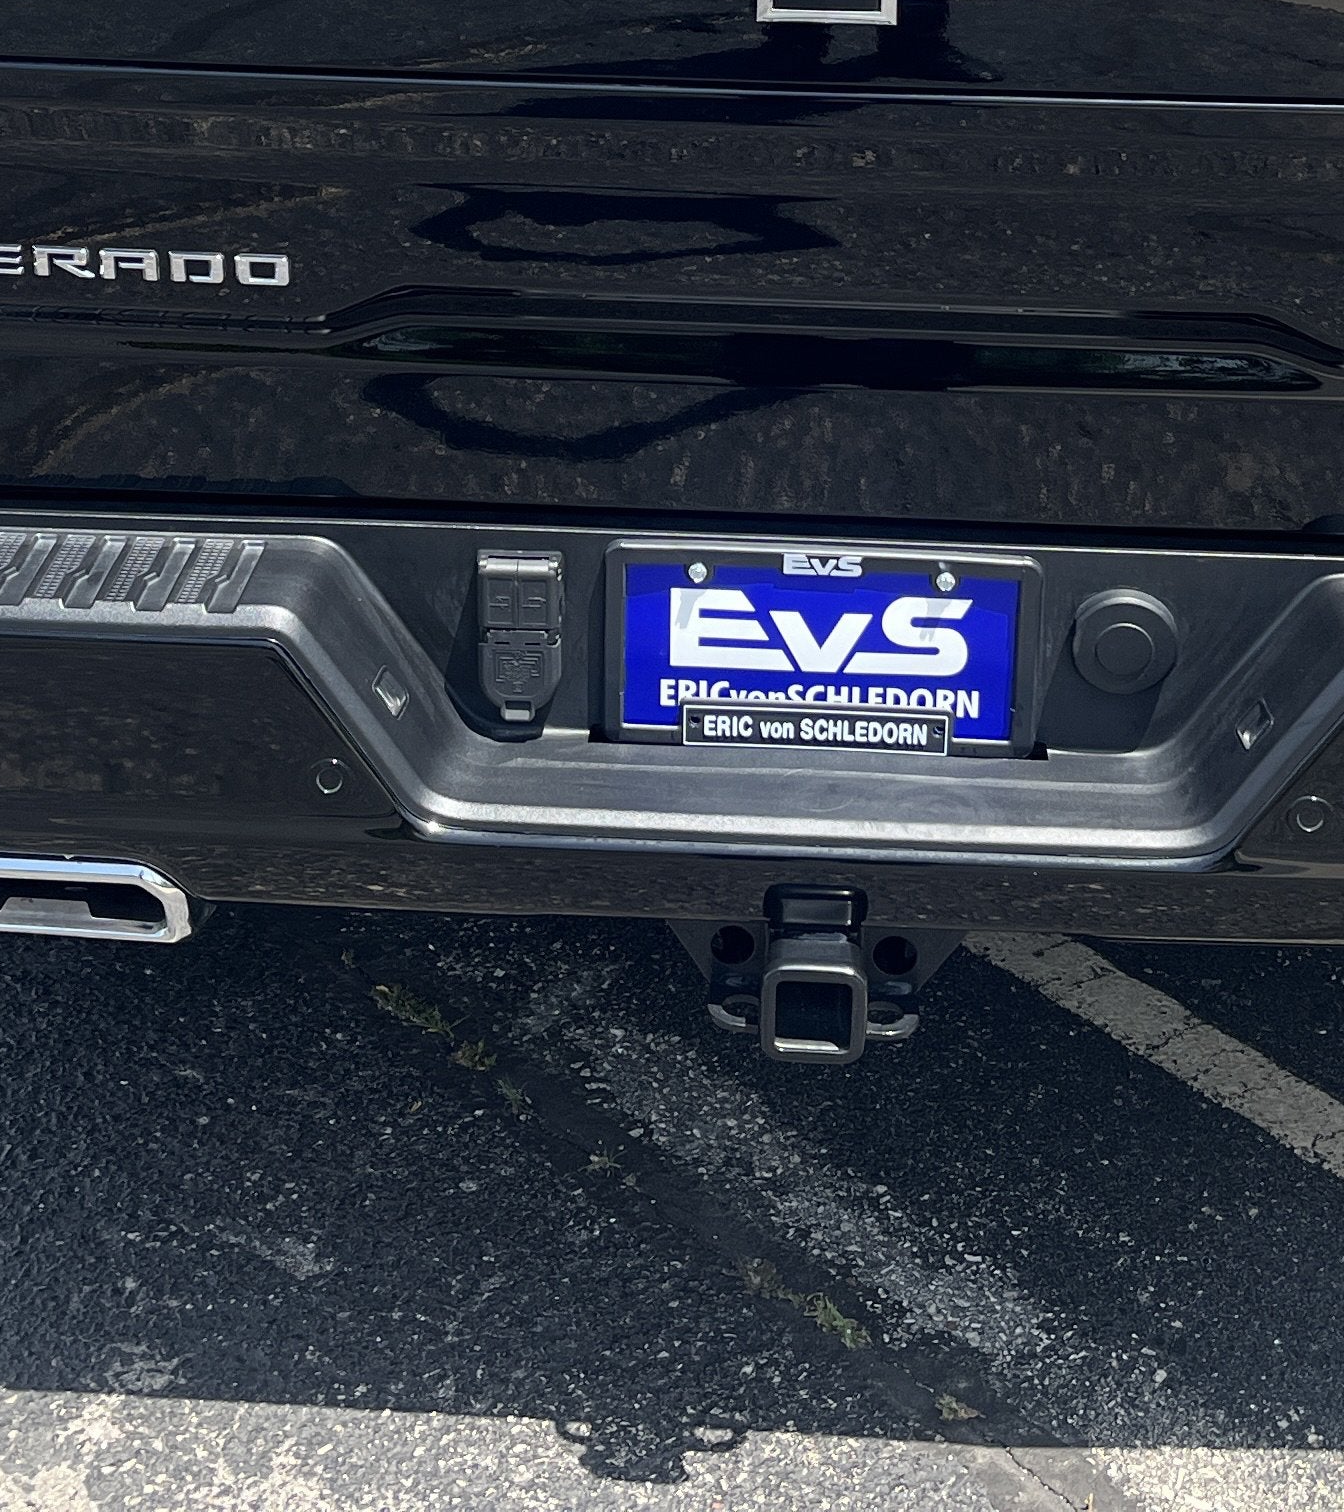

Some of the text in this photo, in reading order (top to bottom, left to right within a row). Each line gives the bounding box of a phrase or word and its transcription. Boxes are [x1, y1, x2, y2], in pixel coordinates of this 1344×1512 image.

[703, 714, 928, 746] ERIC von SCHLEDORN
